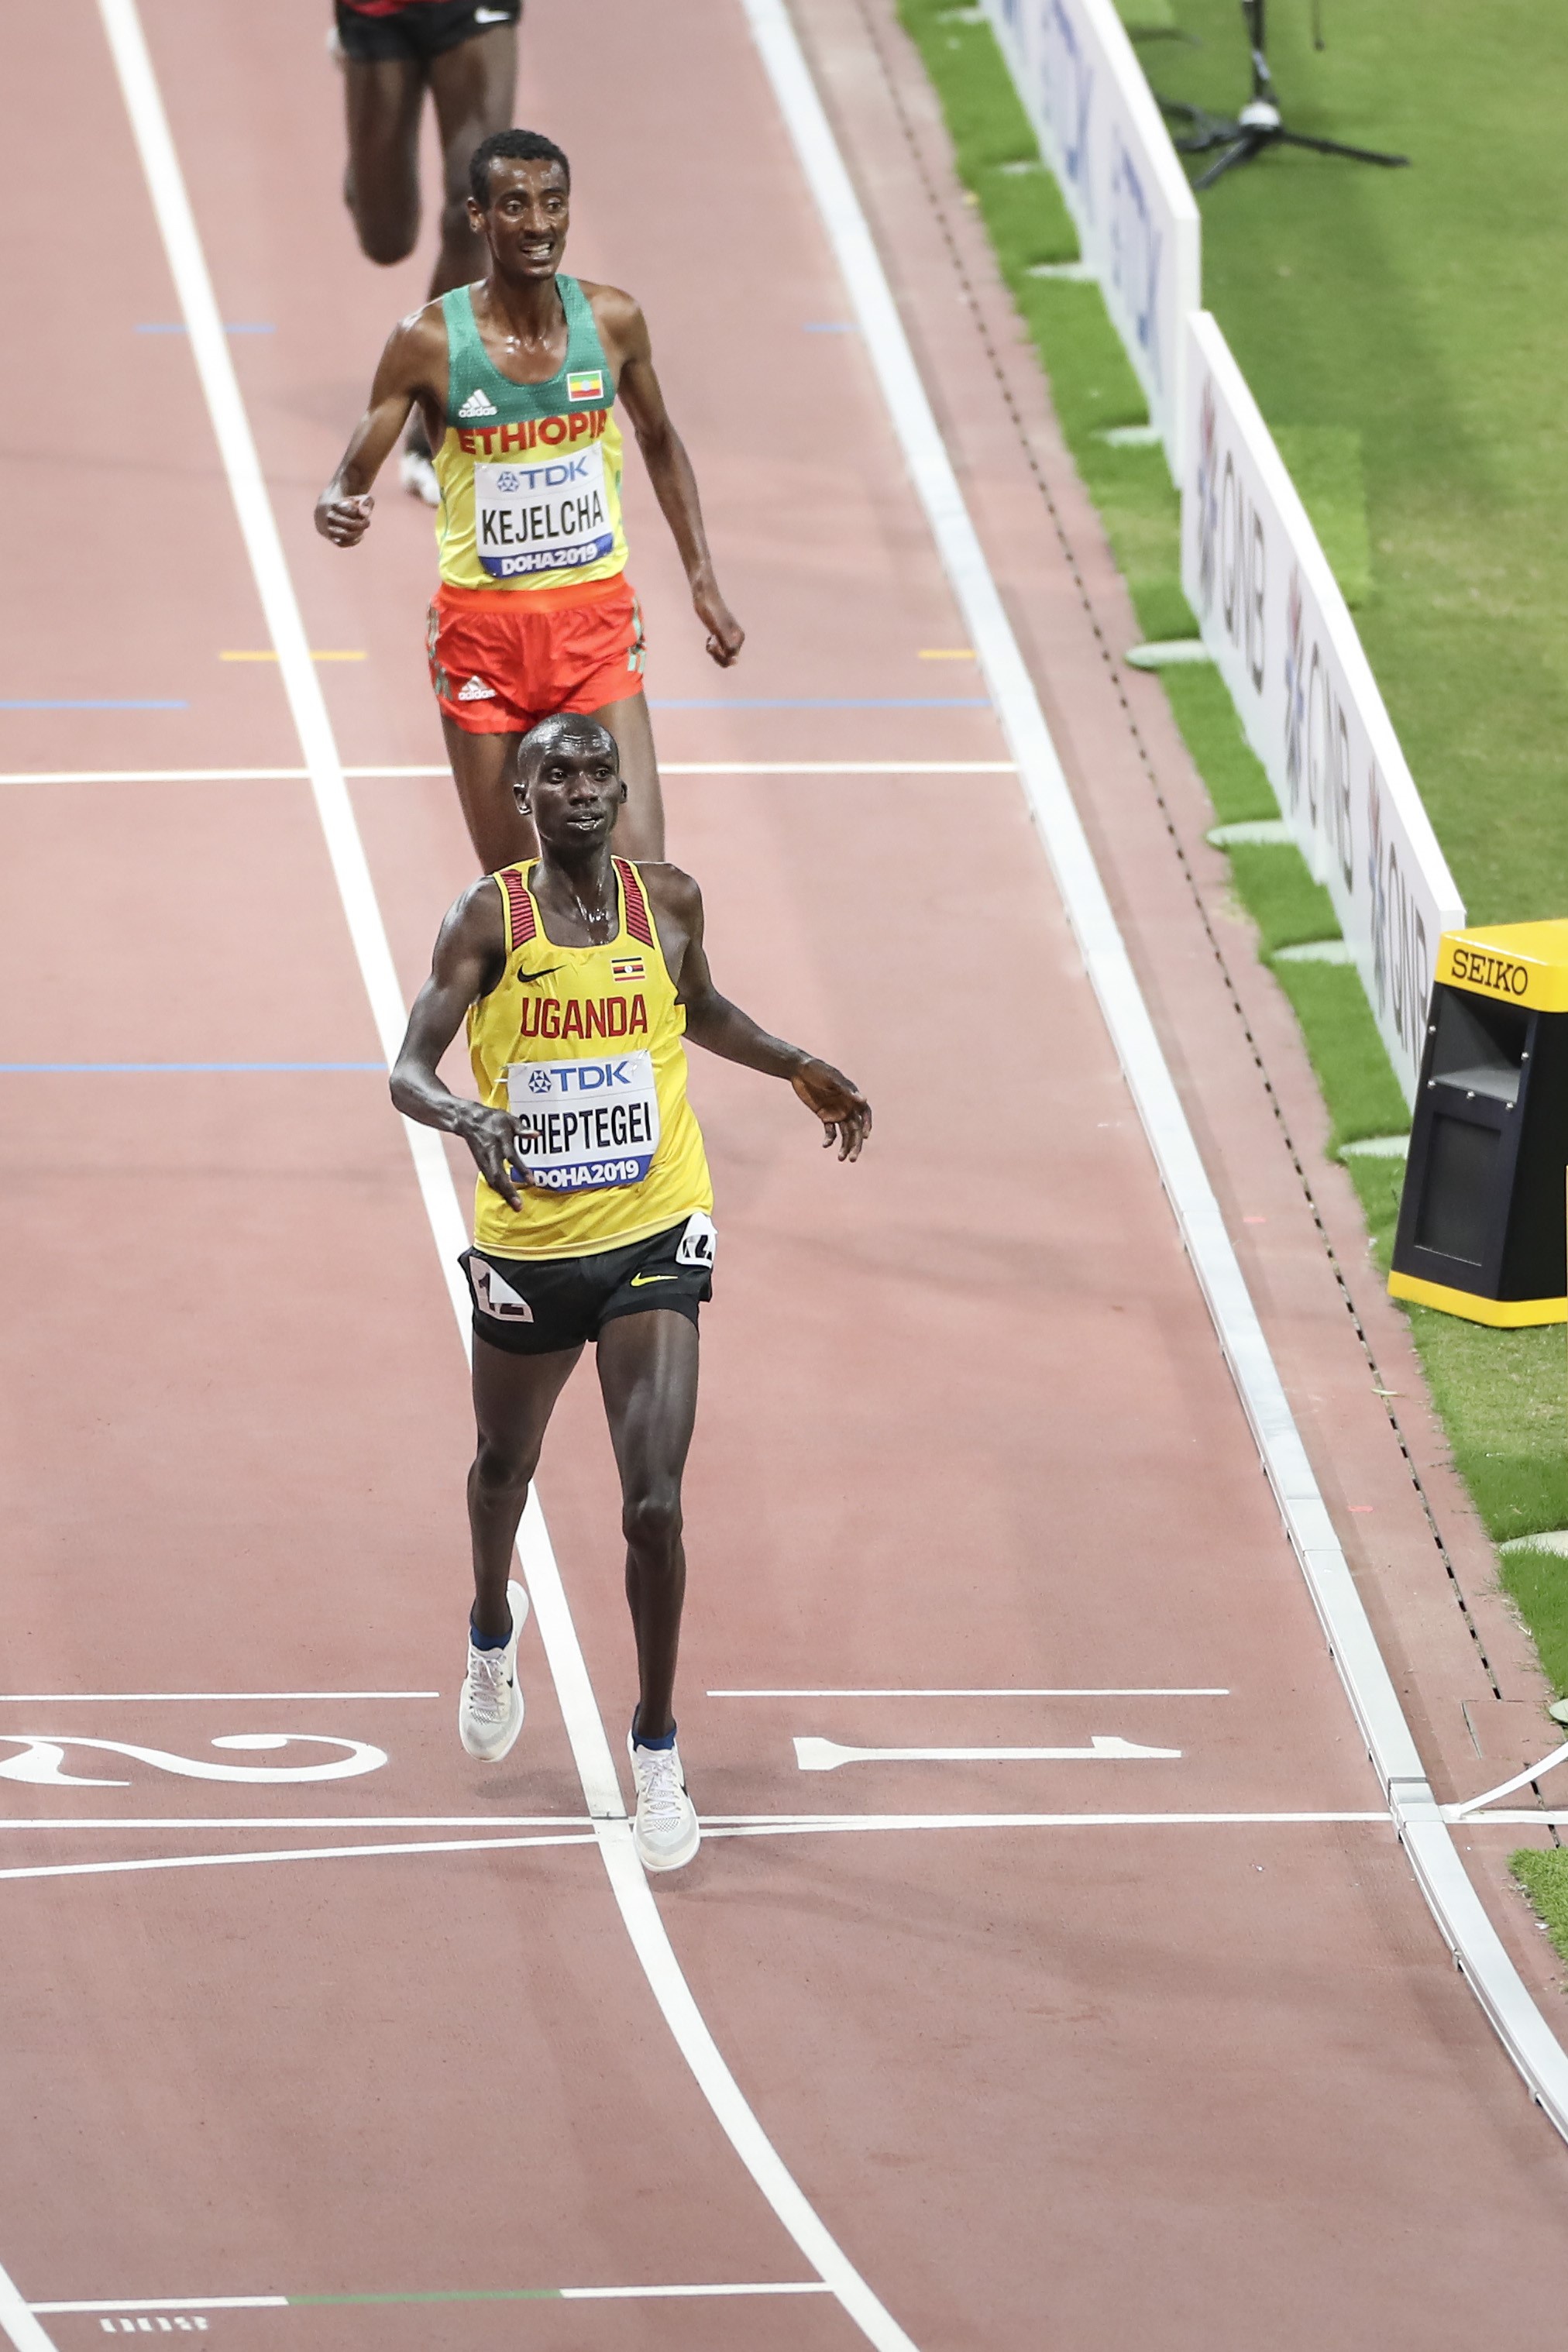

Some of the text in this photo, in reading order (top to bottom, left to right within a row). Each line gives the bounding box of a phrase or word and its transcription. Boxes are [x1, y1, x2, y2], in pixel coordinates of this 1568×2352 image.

[459, 406, 497, 418] adidas
[519, 456, 589, 490] TDK
[482, 490, 604, 545] KEJELCHA
[501, 543, 598, 576] DOHA2019
[1451, 948, 1528, 996] SEIKO
[521, 994, 648, 1040] UGANDA
[550, 1061, 631, 1092] TDK
[518, 1102, 652, 1155] CHEPTEGEI
[534, 1159, 639, 1188] DOHA2019
